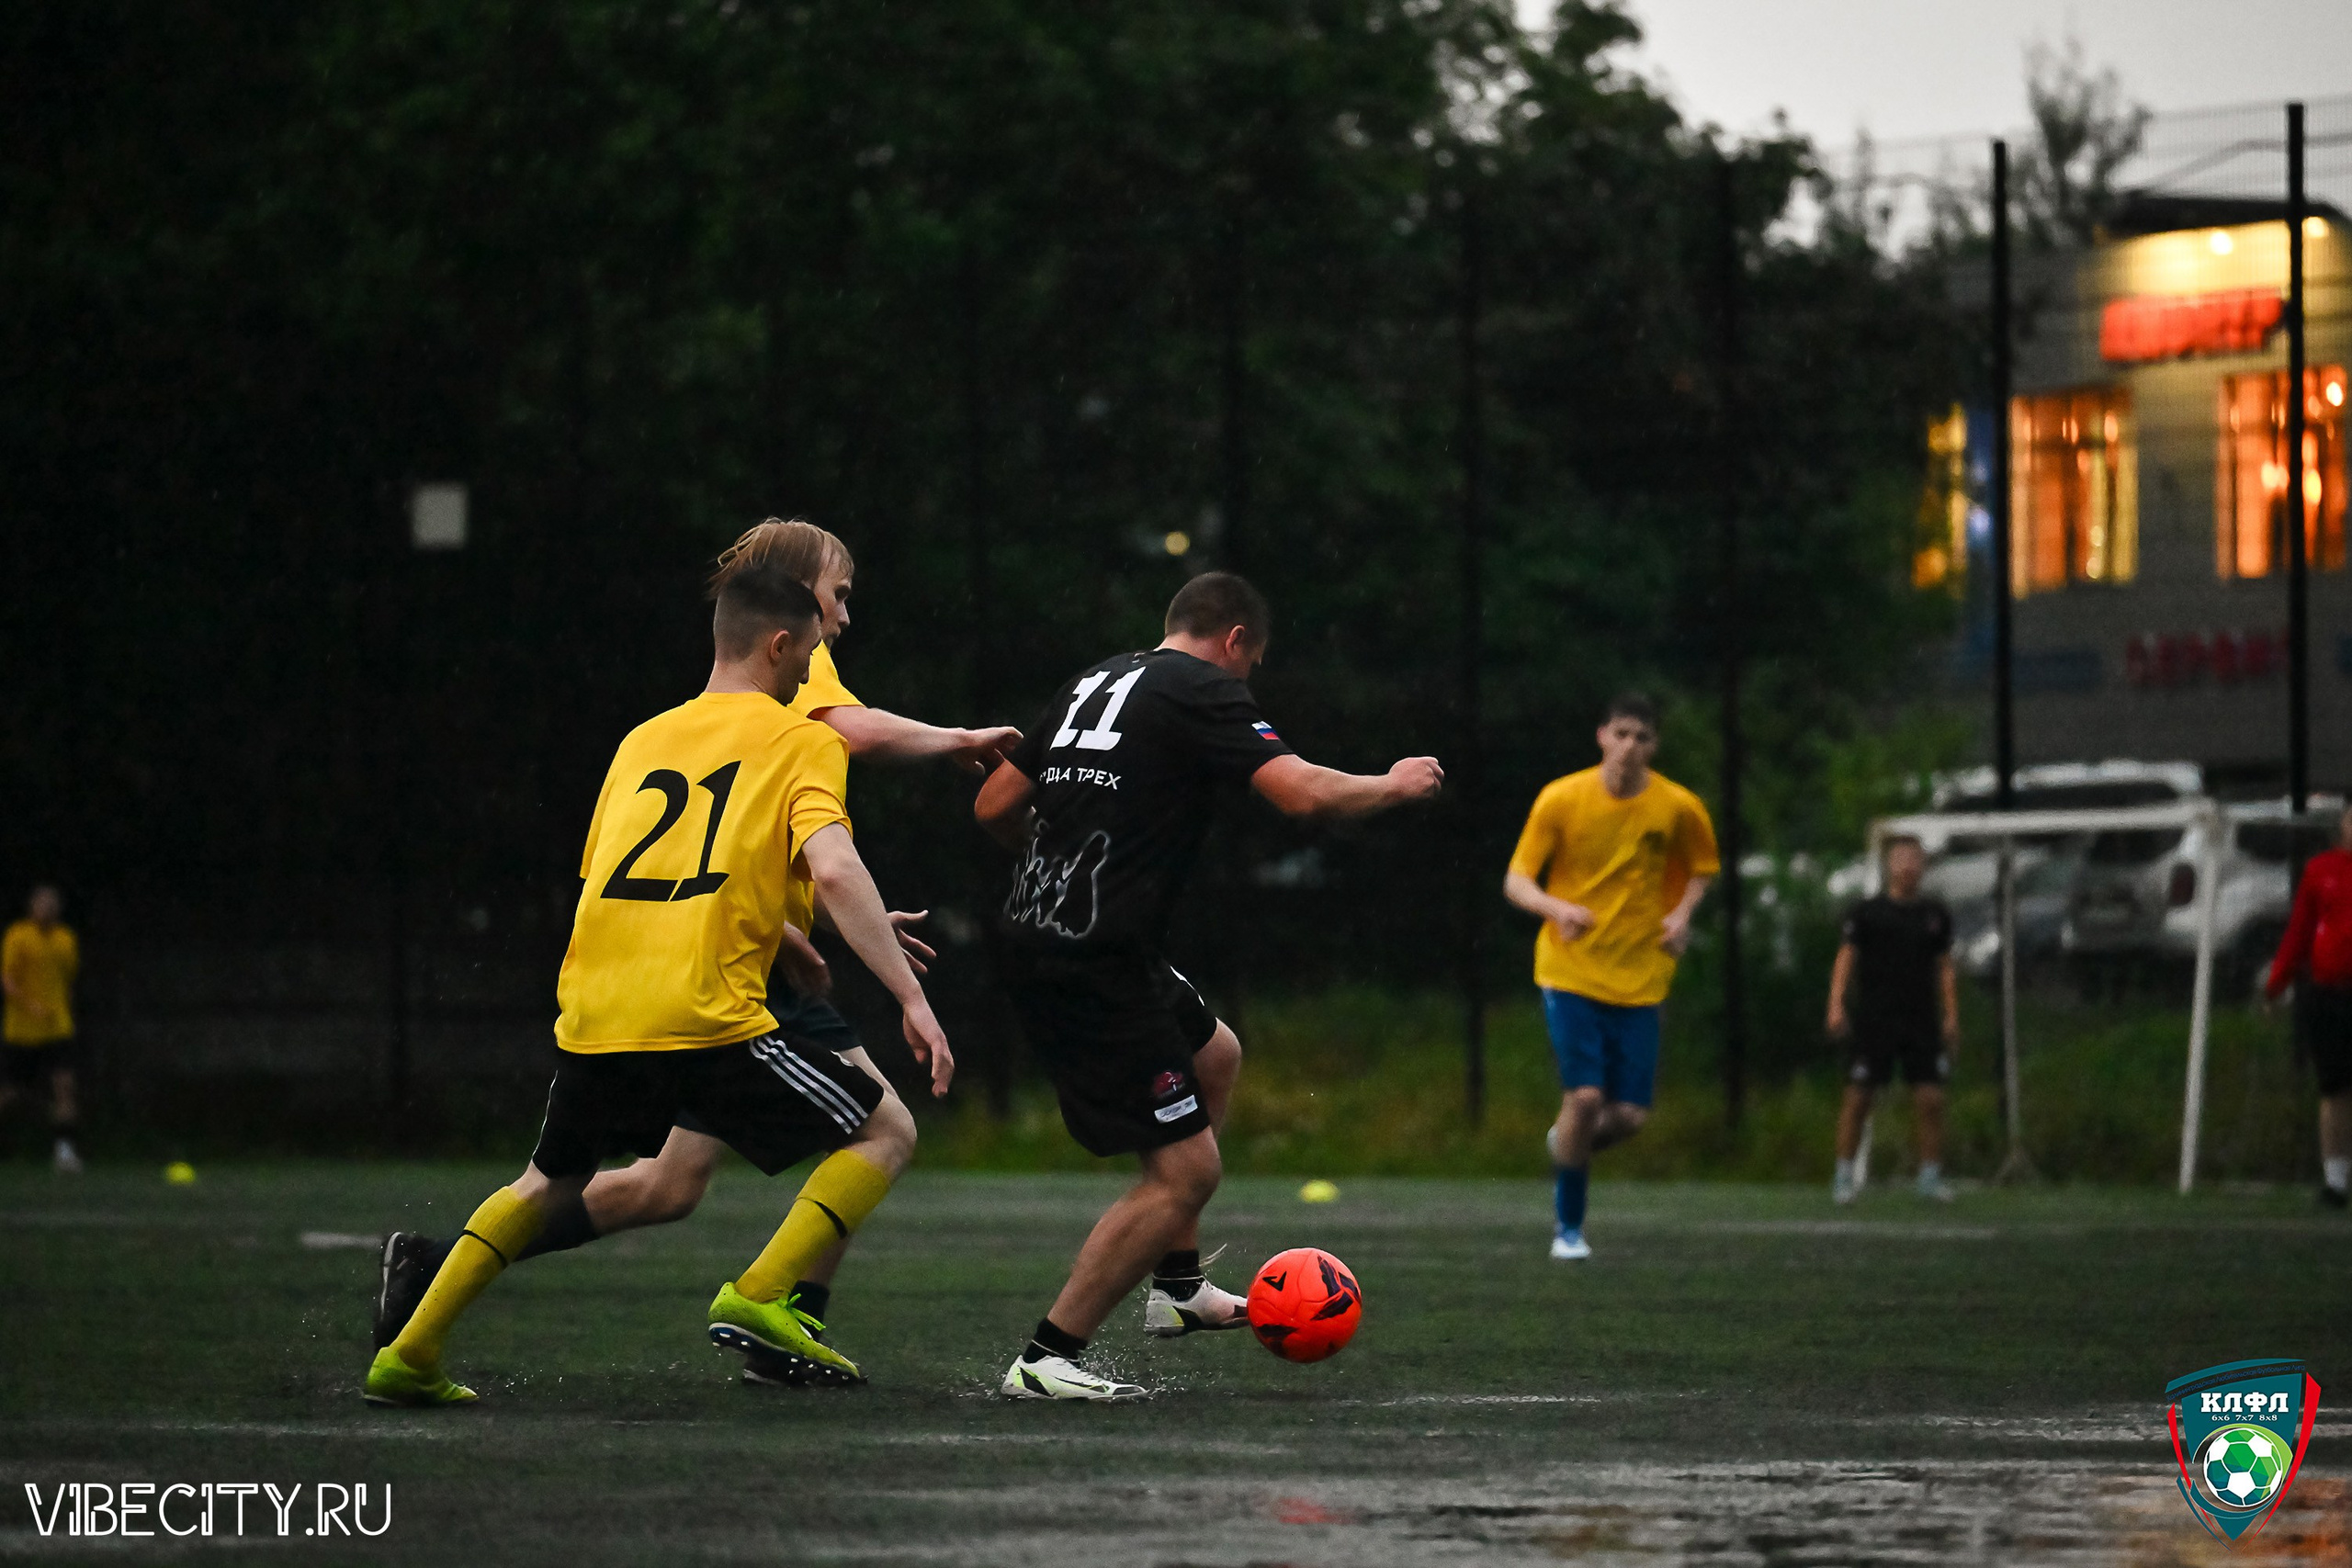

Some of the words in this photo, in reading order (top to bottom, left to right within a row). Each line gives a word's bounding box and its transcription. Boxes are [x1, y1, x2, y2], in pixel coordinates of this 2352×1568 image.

[1049, 666, 1148, 751] 11
[1077, 767, 1122, 791] ТРЕХ
[600, 761, 741, 902] 21
